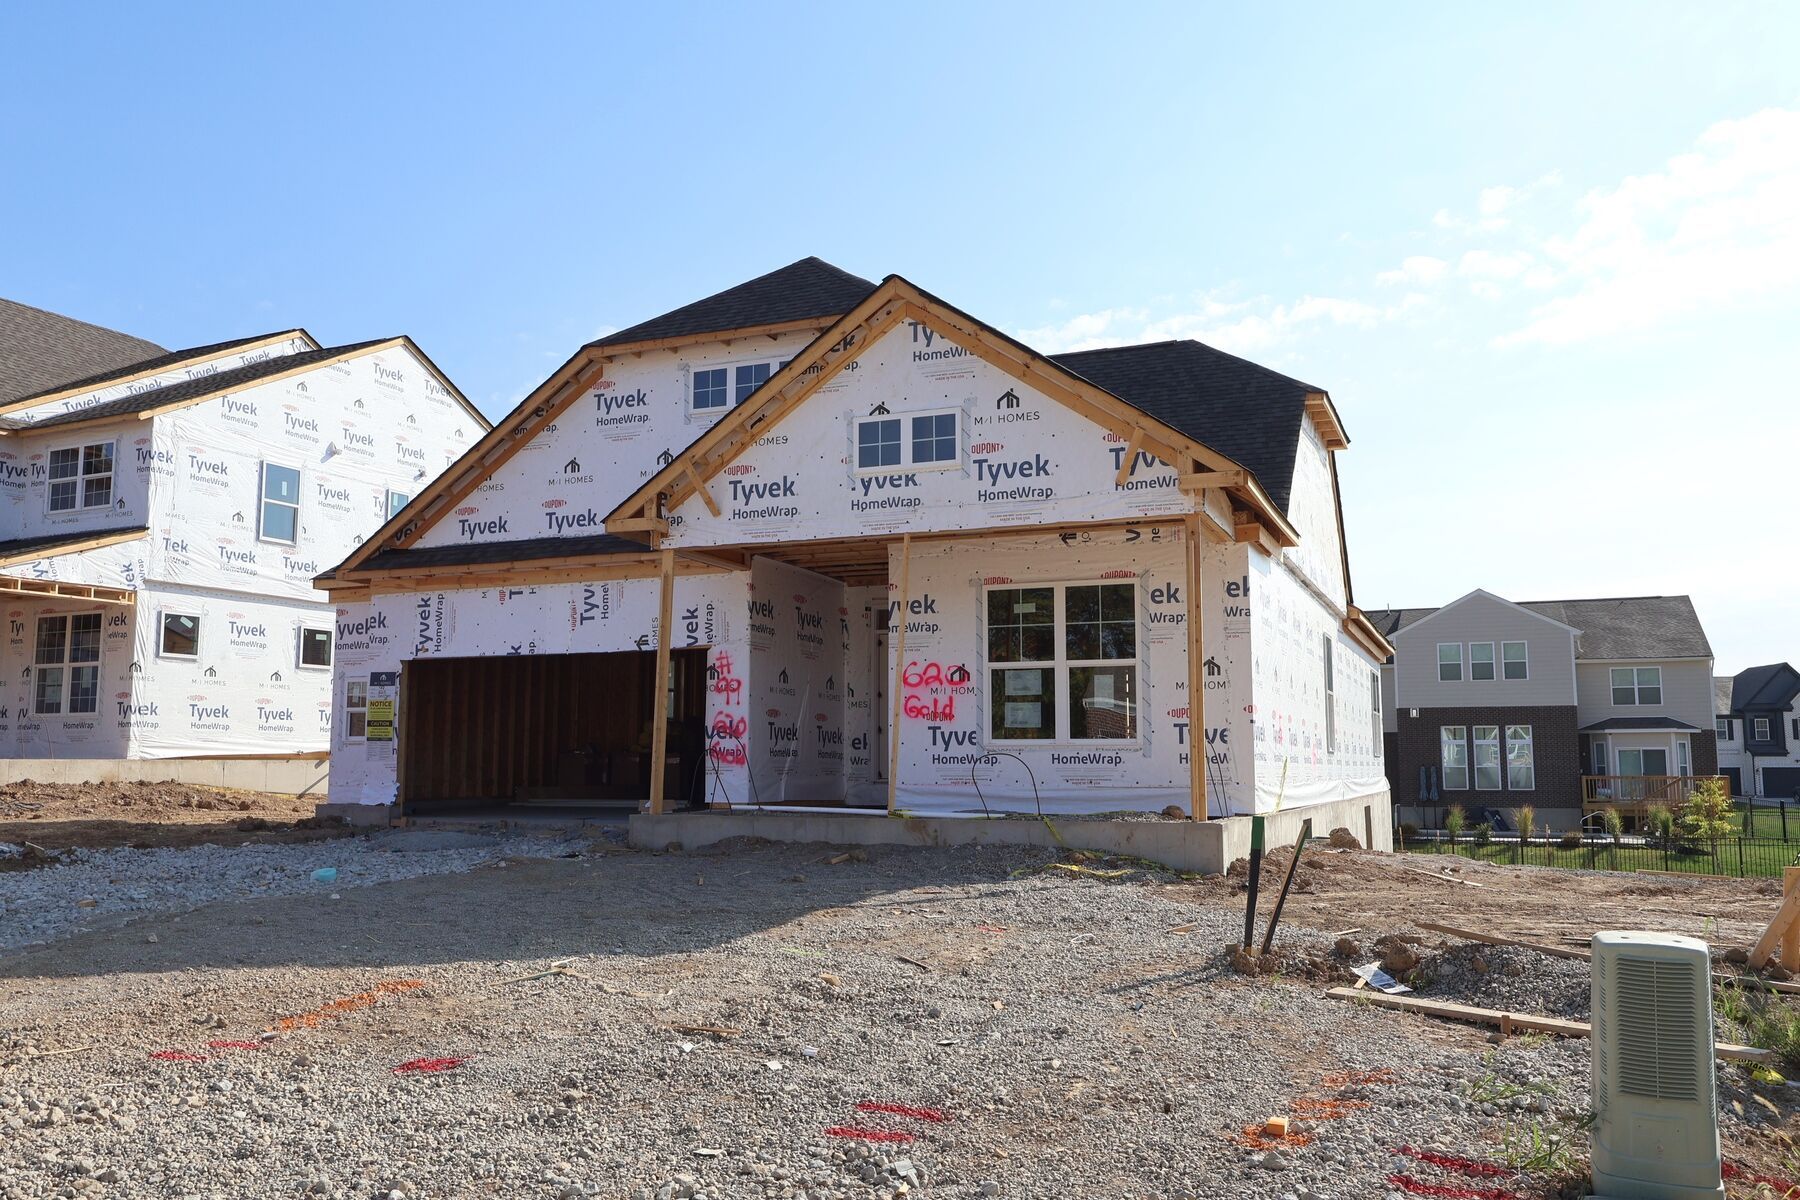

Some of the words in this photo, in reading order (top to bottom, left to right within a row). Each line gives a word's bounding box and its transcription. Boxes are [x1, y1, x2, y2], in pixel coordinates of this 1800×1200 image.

[374, 362, 403, 382] Tyvek
[221, 396, 257, 416] Tyvek
[594, 389, 647, 415] Tyvek
[221, 412, 258, 428] HomeWrap
[284, 412, 318, 432] Tyvek
[597, 414, 648, 426] HomeWrap
[998, 411, 1040, 423] HOMES
[286, 430, 319, 443] HomeWrap
[343, 428, 374, 447] Tyvek
[396, 443, 425, 460] Tyvek
[188, 455, 228, 475] Tyvek
[728, 465, 752, 475] DUPONT
[973, 454, 1050, 486] Tyvek
[190, 474, 228, 488] HomeWrap
[564, 475, 593, 484] HOMES
[317, 484, 350, 501] Tyvek
[729, 476, 795, 506] Tyvek
[978, 487, 1053, 502] HomeWrap
[458, 506, 477, 516] DUPONT
[544, 499, 564, 508] DUPONT
[851, 496, 921, 511] HomeWrap
[546, 508, 597, 534] Tyvek
[733, 506, 797, 519] HomeWrap
[459, 516, 508, 540] Tyvek
[218, 546, 255, 564] Tyvek
[283, 556, 318, 573] Tyvek
[415, 597, 433, 656] Tyvek
[434, 594, 445, 652] HomeWrap
[796, 607, 822, 629] Tyvek
[229, 622, 266, 638] Tyvek
[230, 639, 266, 649] HomeWrap
[117, 702, 158, 719] Tyvek
[189, 704, 228, 721] Tyvek
[258, 707, 292, 723] Tyvek
[904, 695, 955, 720] Gold
[63, 722, 94, 731] HomeWrap
[191, 722, 230, 732] HomeWrap
[258, 724, 293, 733] HomeWrap
[768, 722, 798, 746] Tyvek
[817, 726, 843, 748] Tyvek
[932, 753, 998, 766] HomeWrap
[1052, 753, 1122, 766] HomeWrap
